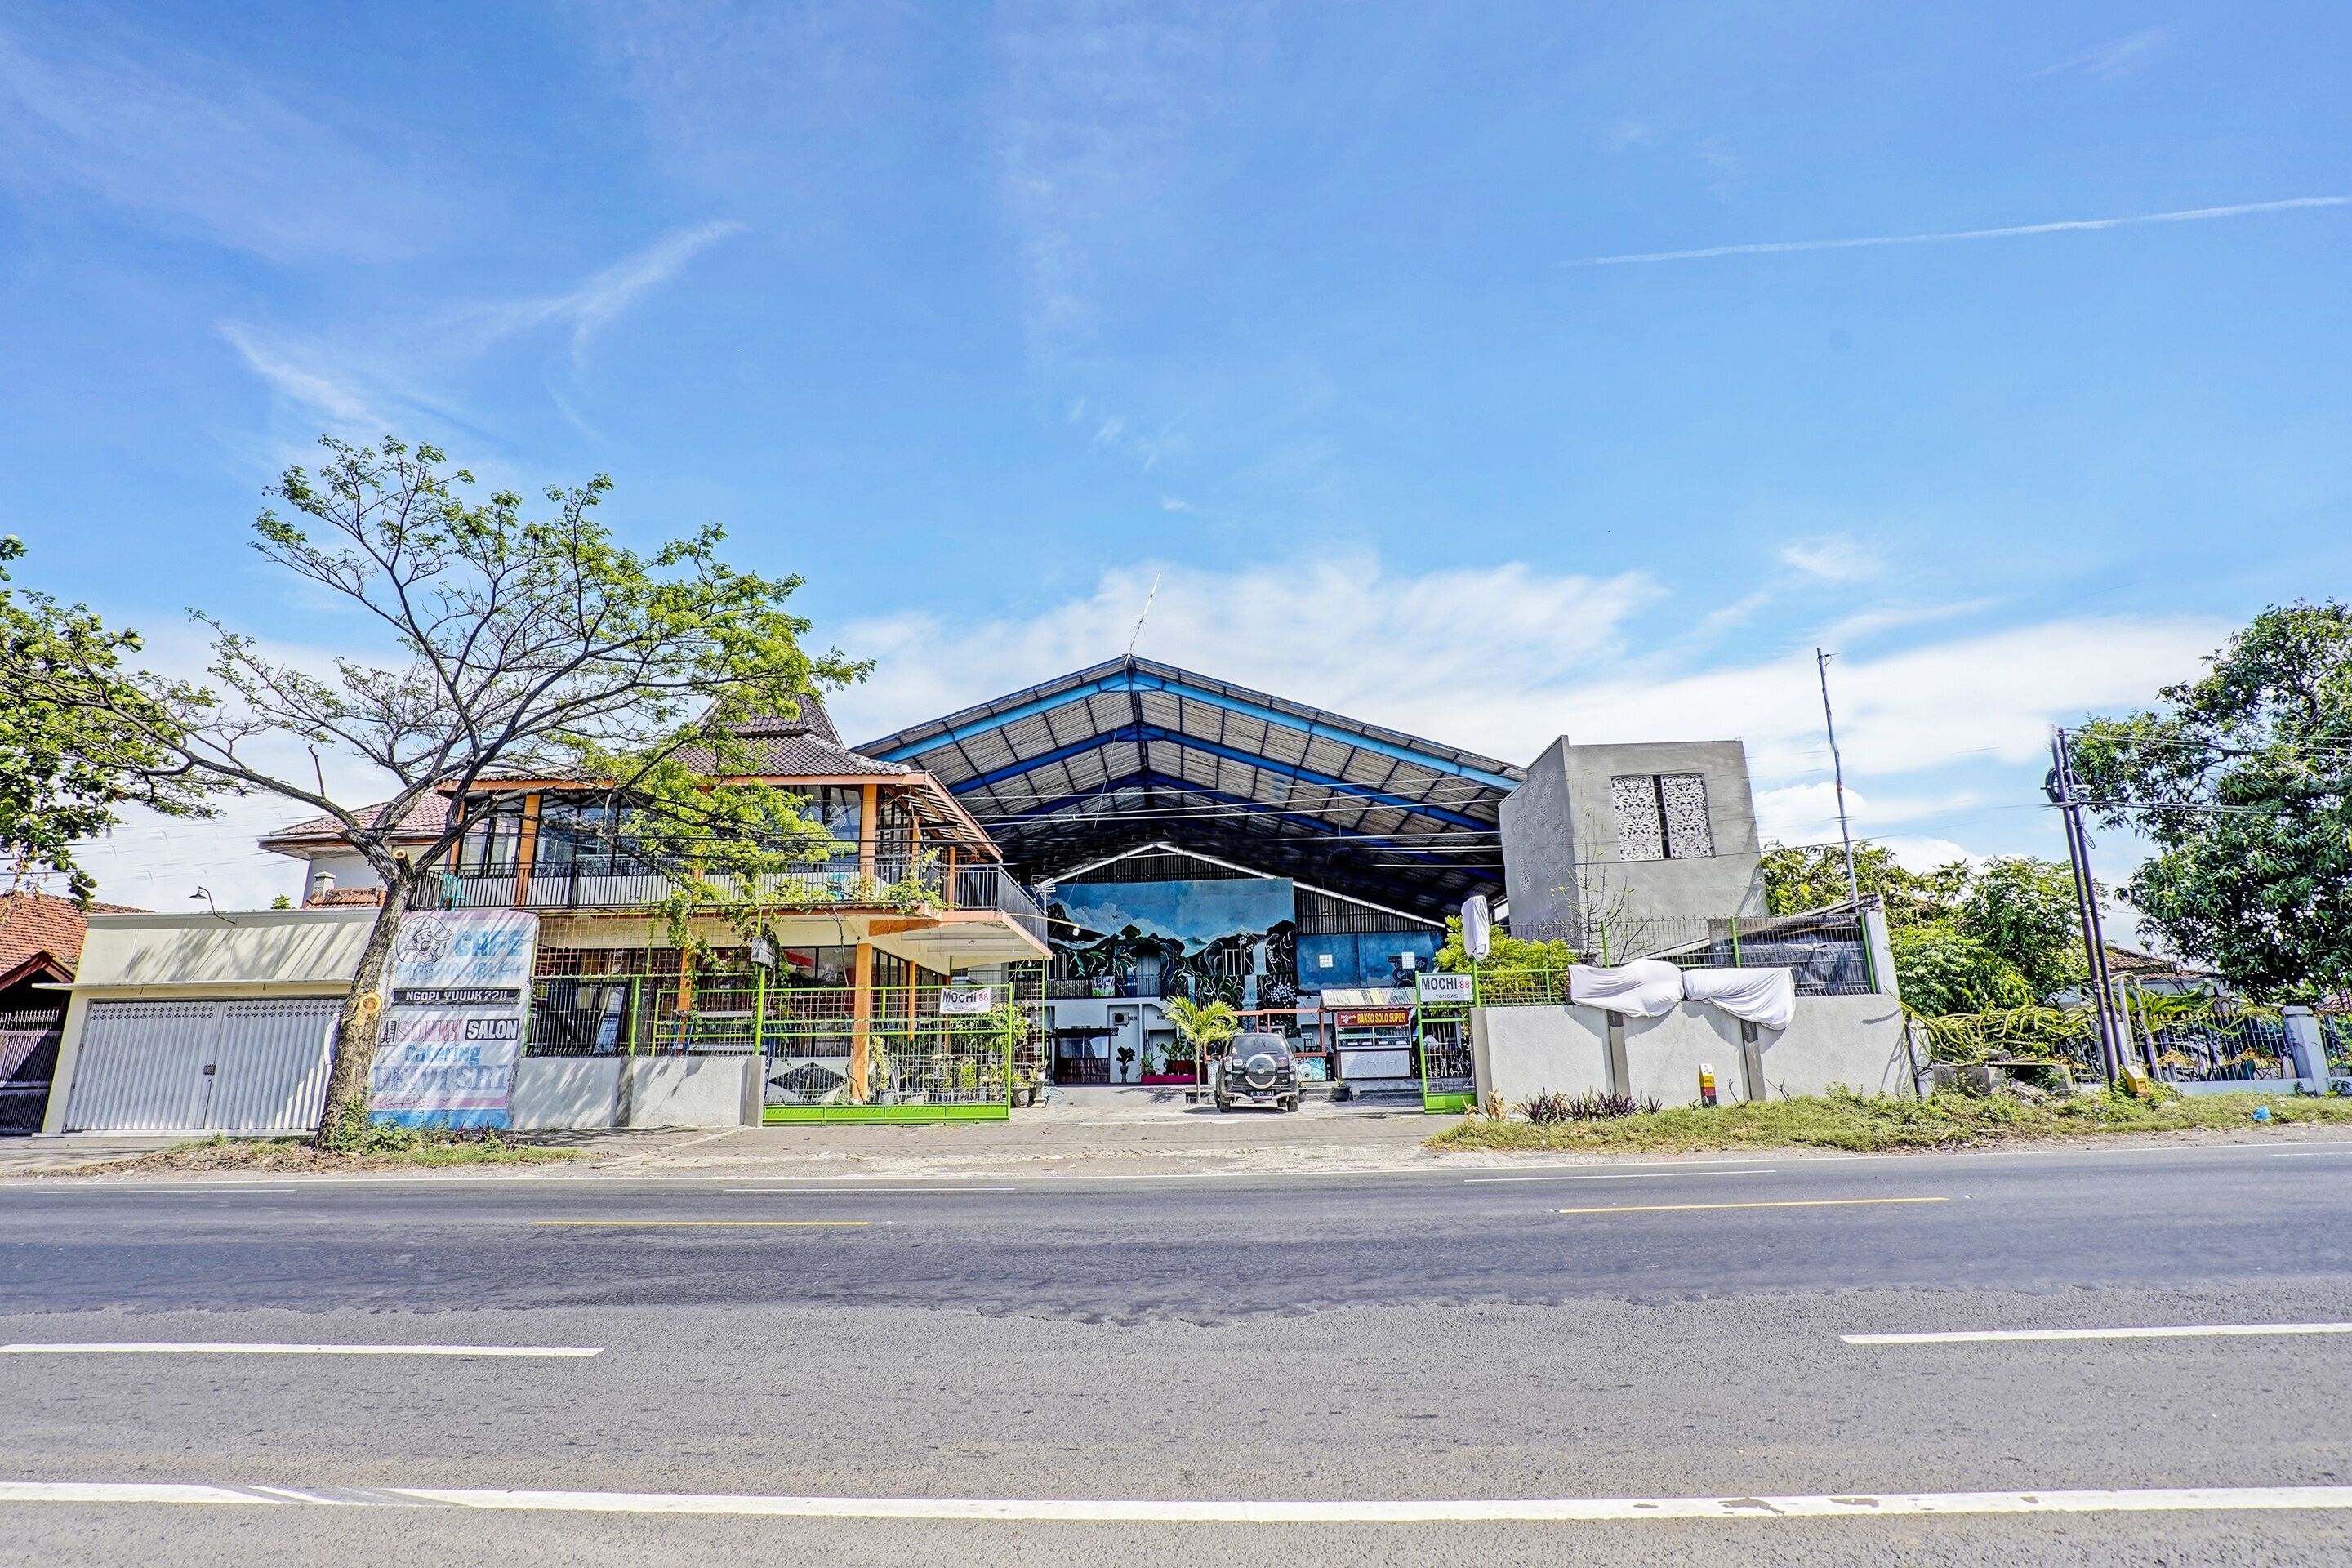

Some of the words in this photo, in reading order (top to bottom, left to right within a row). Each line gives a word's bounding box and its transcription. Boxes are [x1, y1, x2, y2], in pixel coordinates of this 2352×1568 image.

[454, 929, 523, 956] CAFE
[1421, 977, 1457, 990] MOCHI
[1459, 980, 1470, 989] 88
[405, 991, 439, 1001] NGOPI
[942, 991, 977, 1003] MOCHI
[978, 993, 988, 1001] 88
[1357, 1013, 1374, 1024] BAKSO
[1375, 1013, 1388, 1023] SOLO
[1389, 1012, 1405, 1022] SUPER
[467, 1021, 518, 1040] SALON
